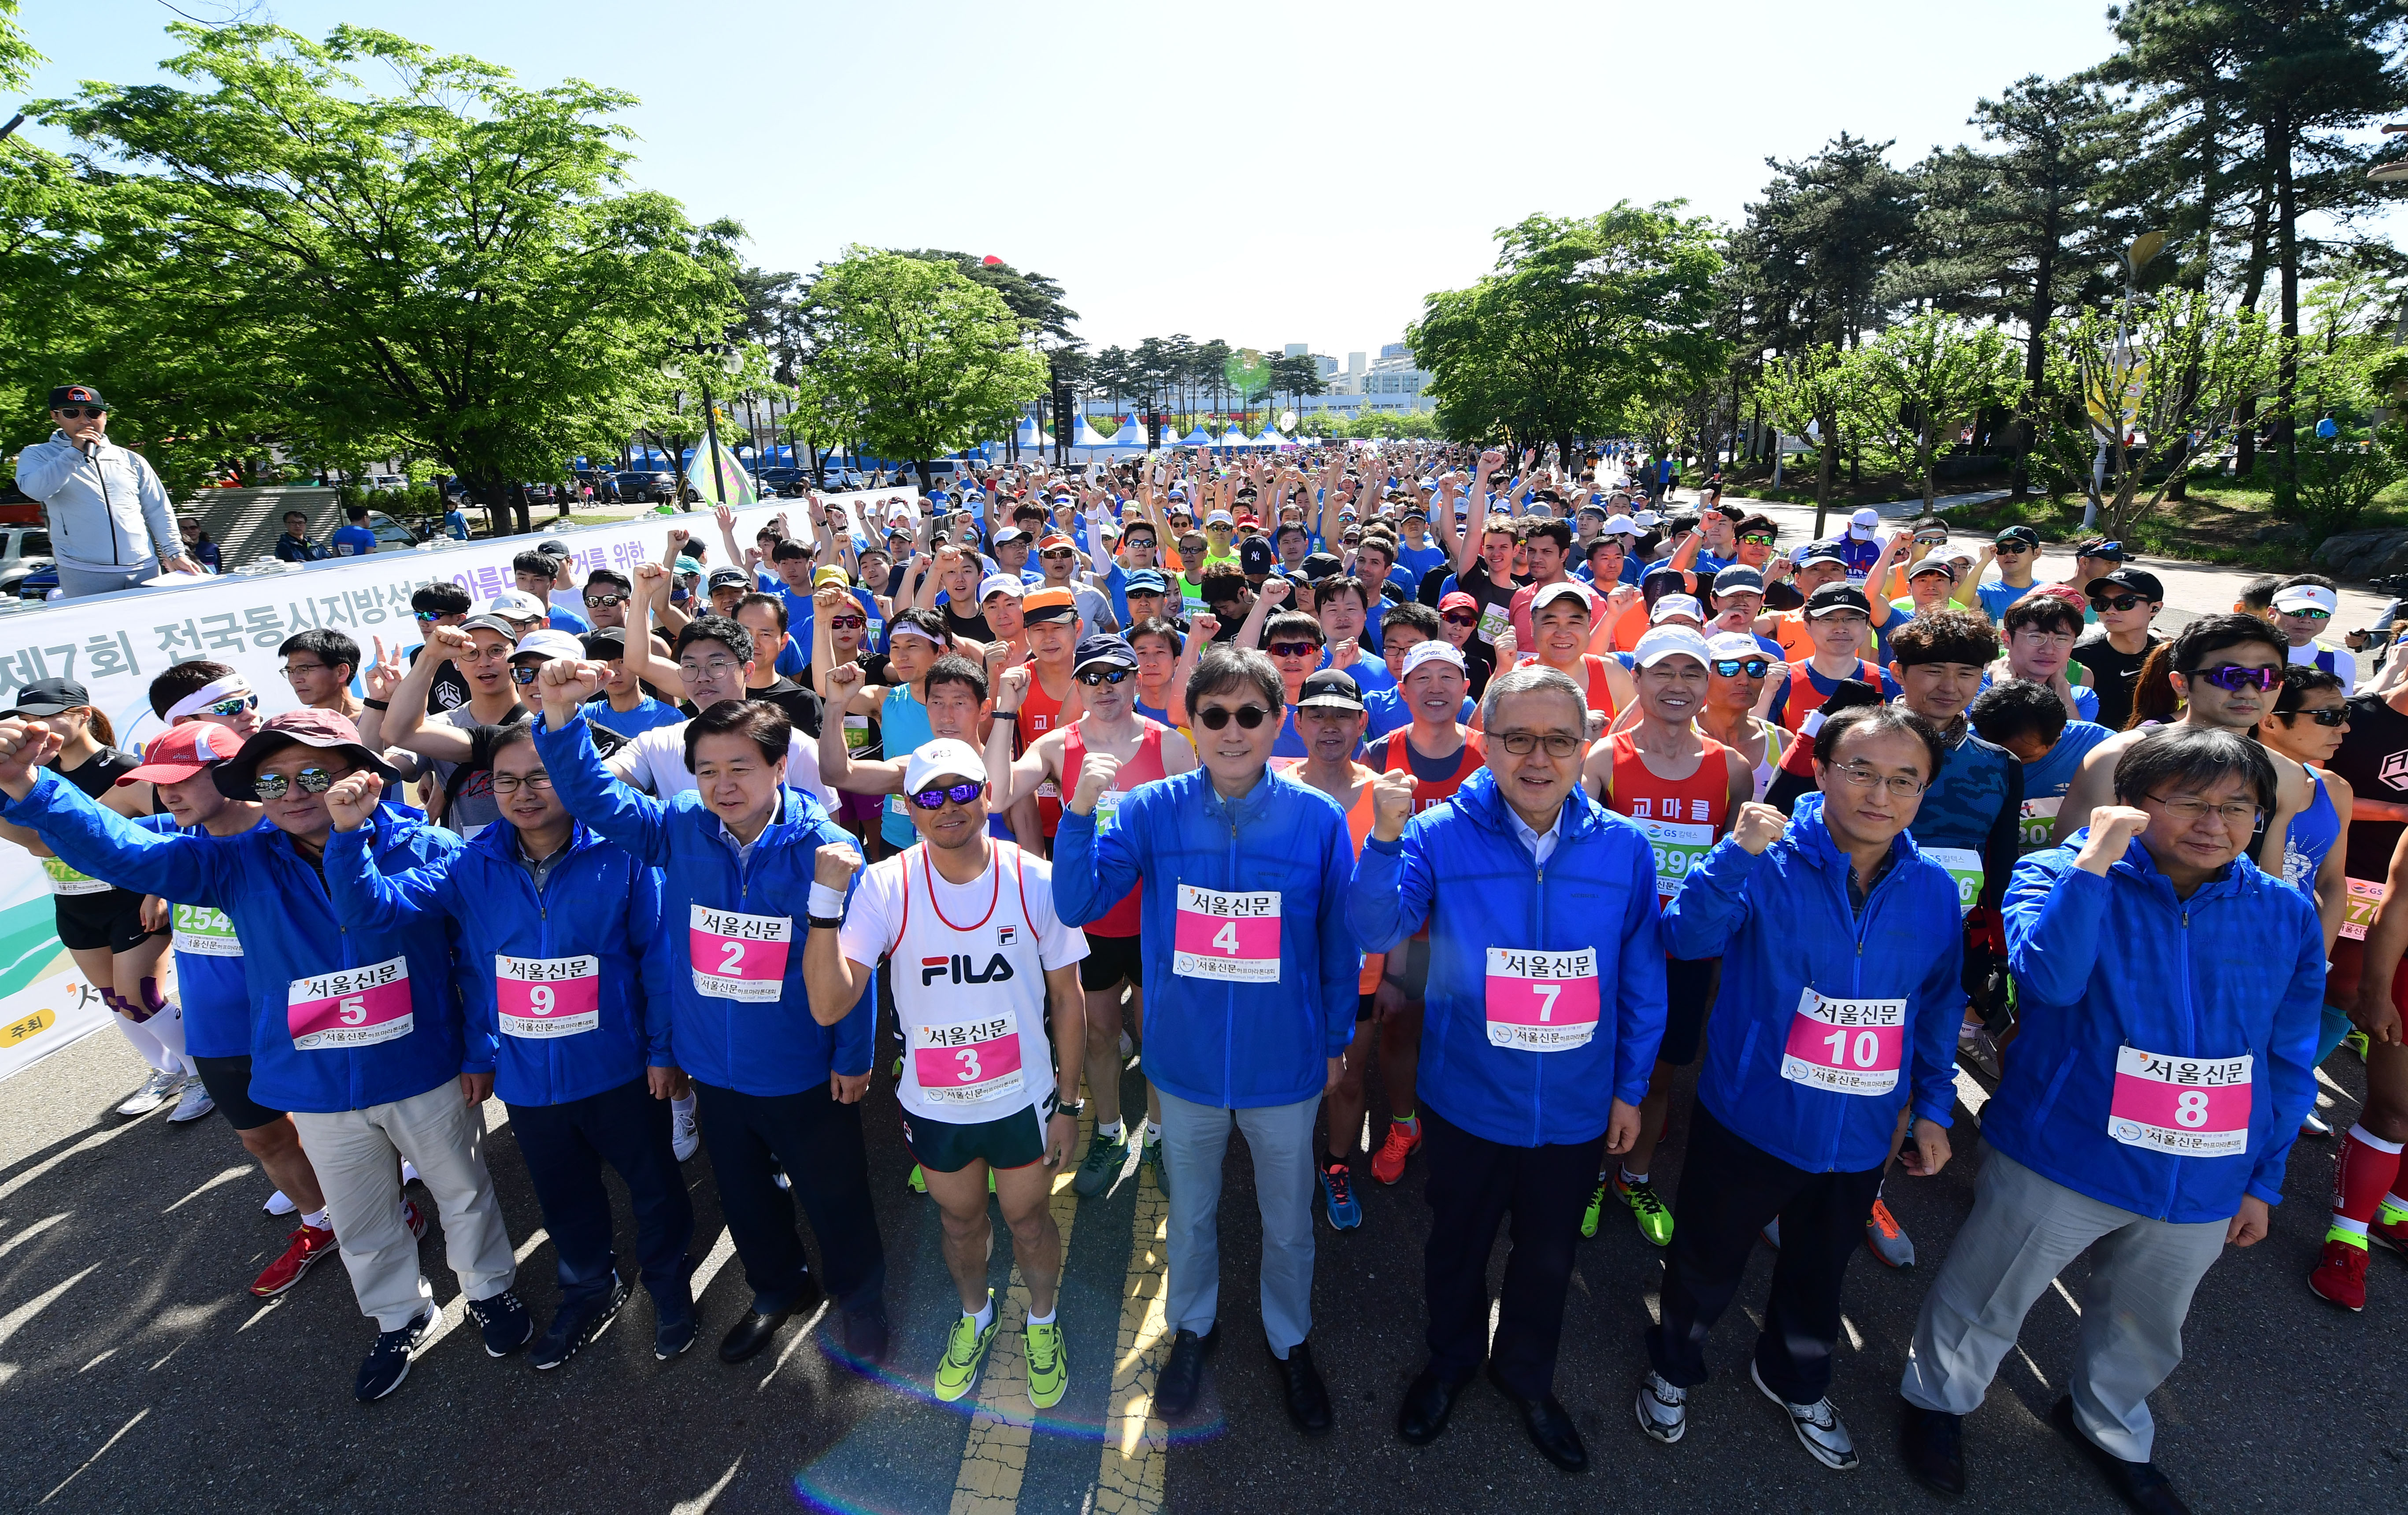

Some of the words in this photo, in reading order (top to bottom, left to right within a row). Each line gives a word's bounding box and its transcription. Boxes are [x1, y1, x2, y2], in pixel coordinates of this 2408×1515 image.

[154, 576, 437, 666] 전국동시지방선
[1664, 829, 1677, 837] GS
[1678, 830, 1698, 839] 칼텍스
[1655, 848, 1705, 874] 896
[1943, 854, 1965, 863] 칼텍스
[1959, 877, 1975, 901] 6
[178, 905, 235, 931] 254
[1193, 894, 1271, 916] 서울신문
[703, 914, 782, 940] 서울신문
[1213, 922, 1239, 955] 4
[510, 960, 588, 980] 서울신문
[717, 941, 745, 975] 2
[922, 953, 1014, 986] FILA
[1506, 956, 1589, 978] 서울신문
[307, 964, 397, 997] 서울신문
[340, 995, 367, 1025] 5
[530, 985, 555, 1015] 9
[1533, 984, 1561, 1022] 7
[1814, 1002, 1897, 1025] 서울신문
[11, 1016, 43, 1039] 주최
[930, 1019, 1007, 1046] 서울신문
[1824, 1030, 1878, 1067] 10
[955, 1048, 982, 1082] 3
[2144, 1059, 2243, 1085] 서울신문
[2175, 1090, 2208, 1128] 8
